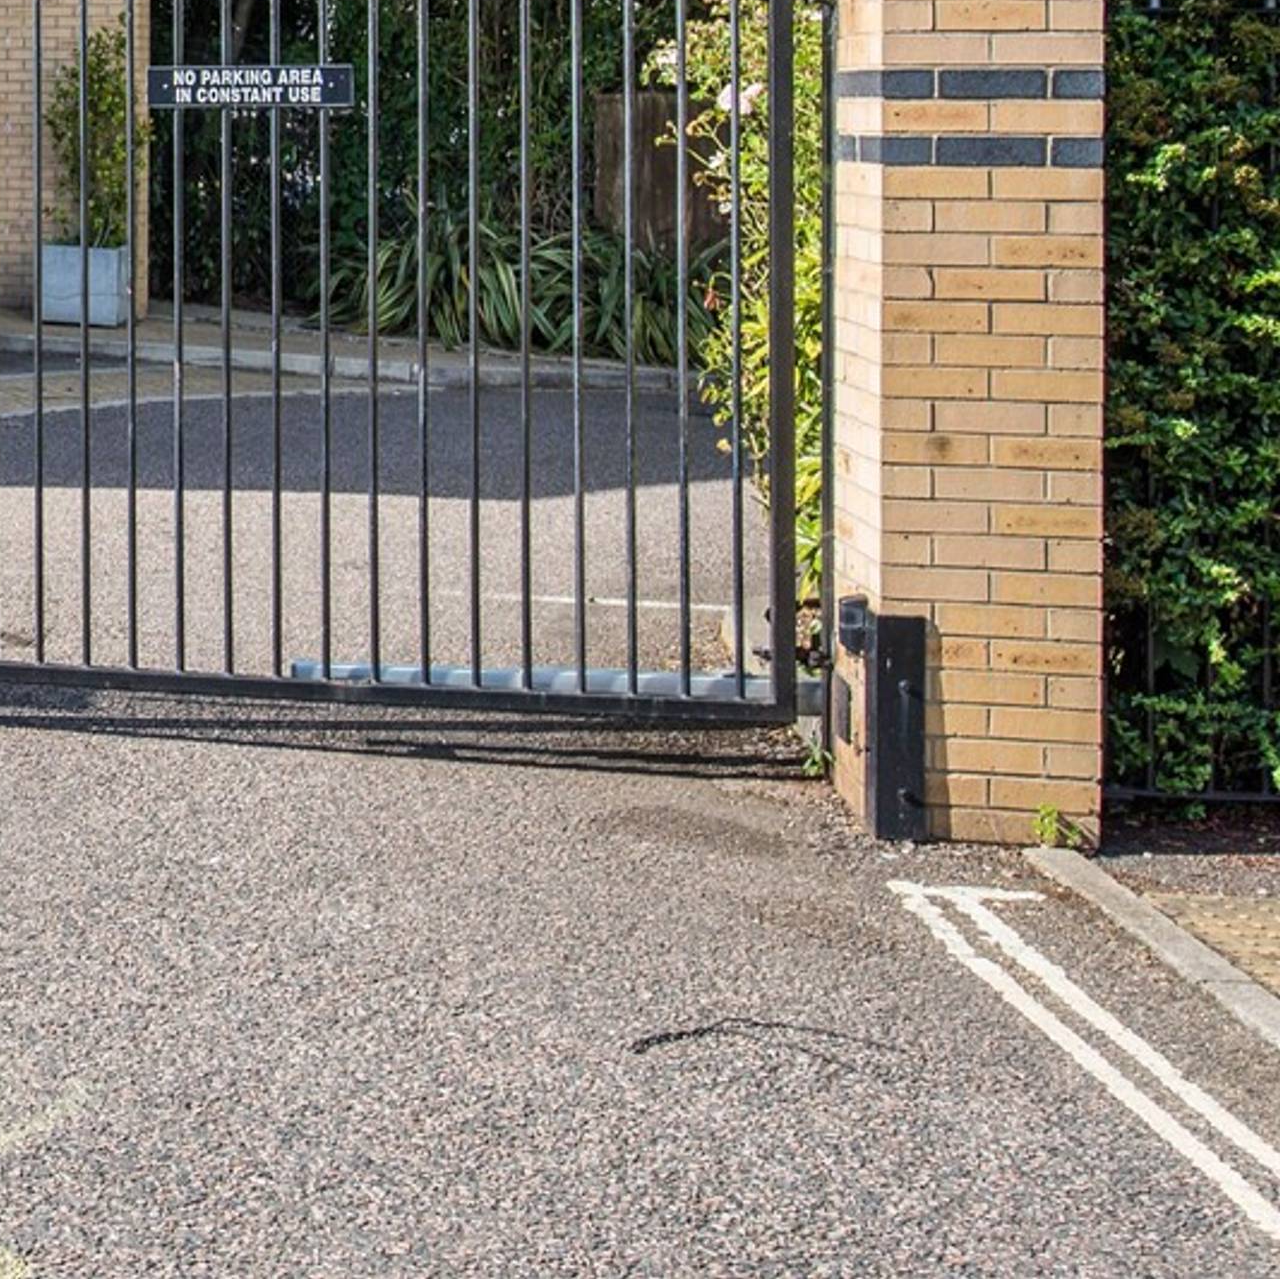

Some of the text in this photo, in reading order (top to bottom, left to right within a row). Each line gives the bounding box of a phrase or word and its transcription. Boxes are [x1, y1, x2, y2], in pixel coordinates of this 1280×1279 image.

[173, 69, 324, 86] NO PARKING AREA
[175, 86, 322, 103] IN CONSTANT USE
